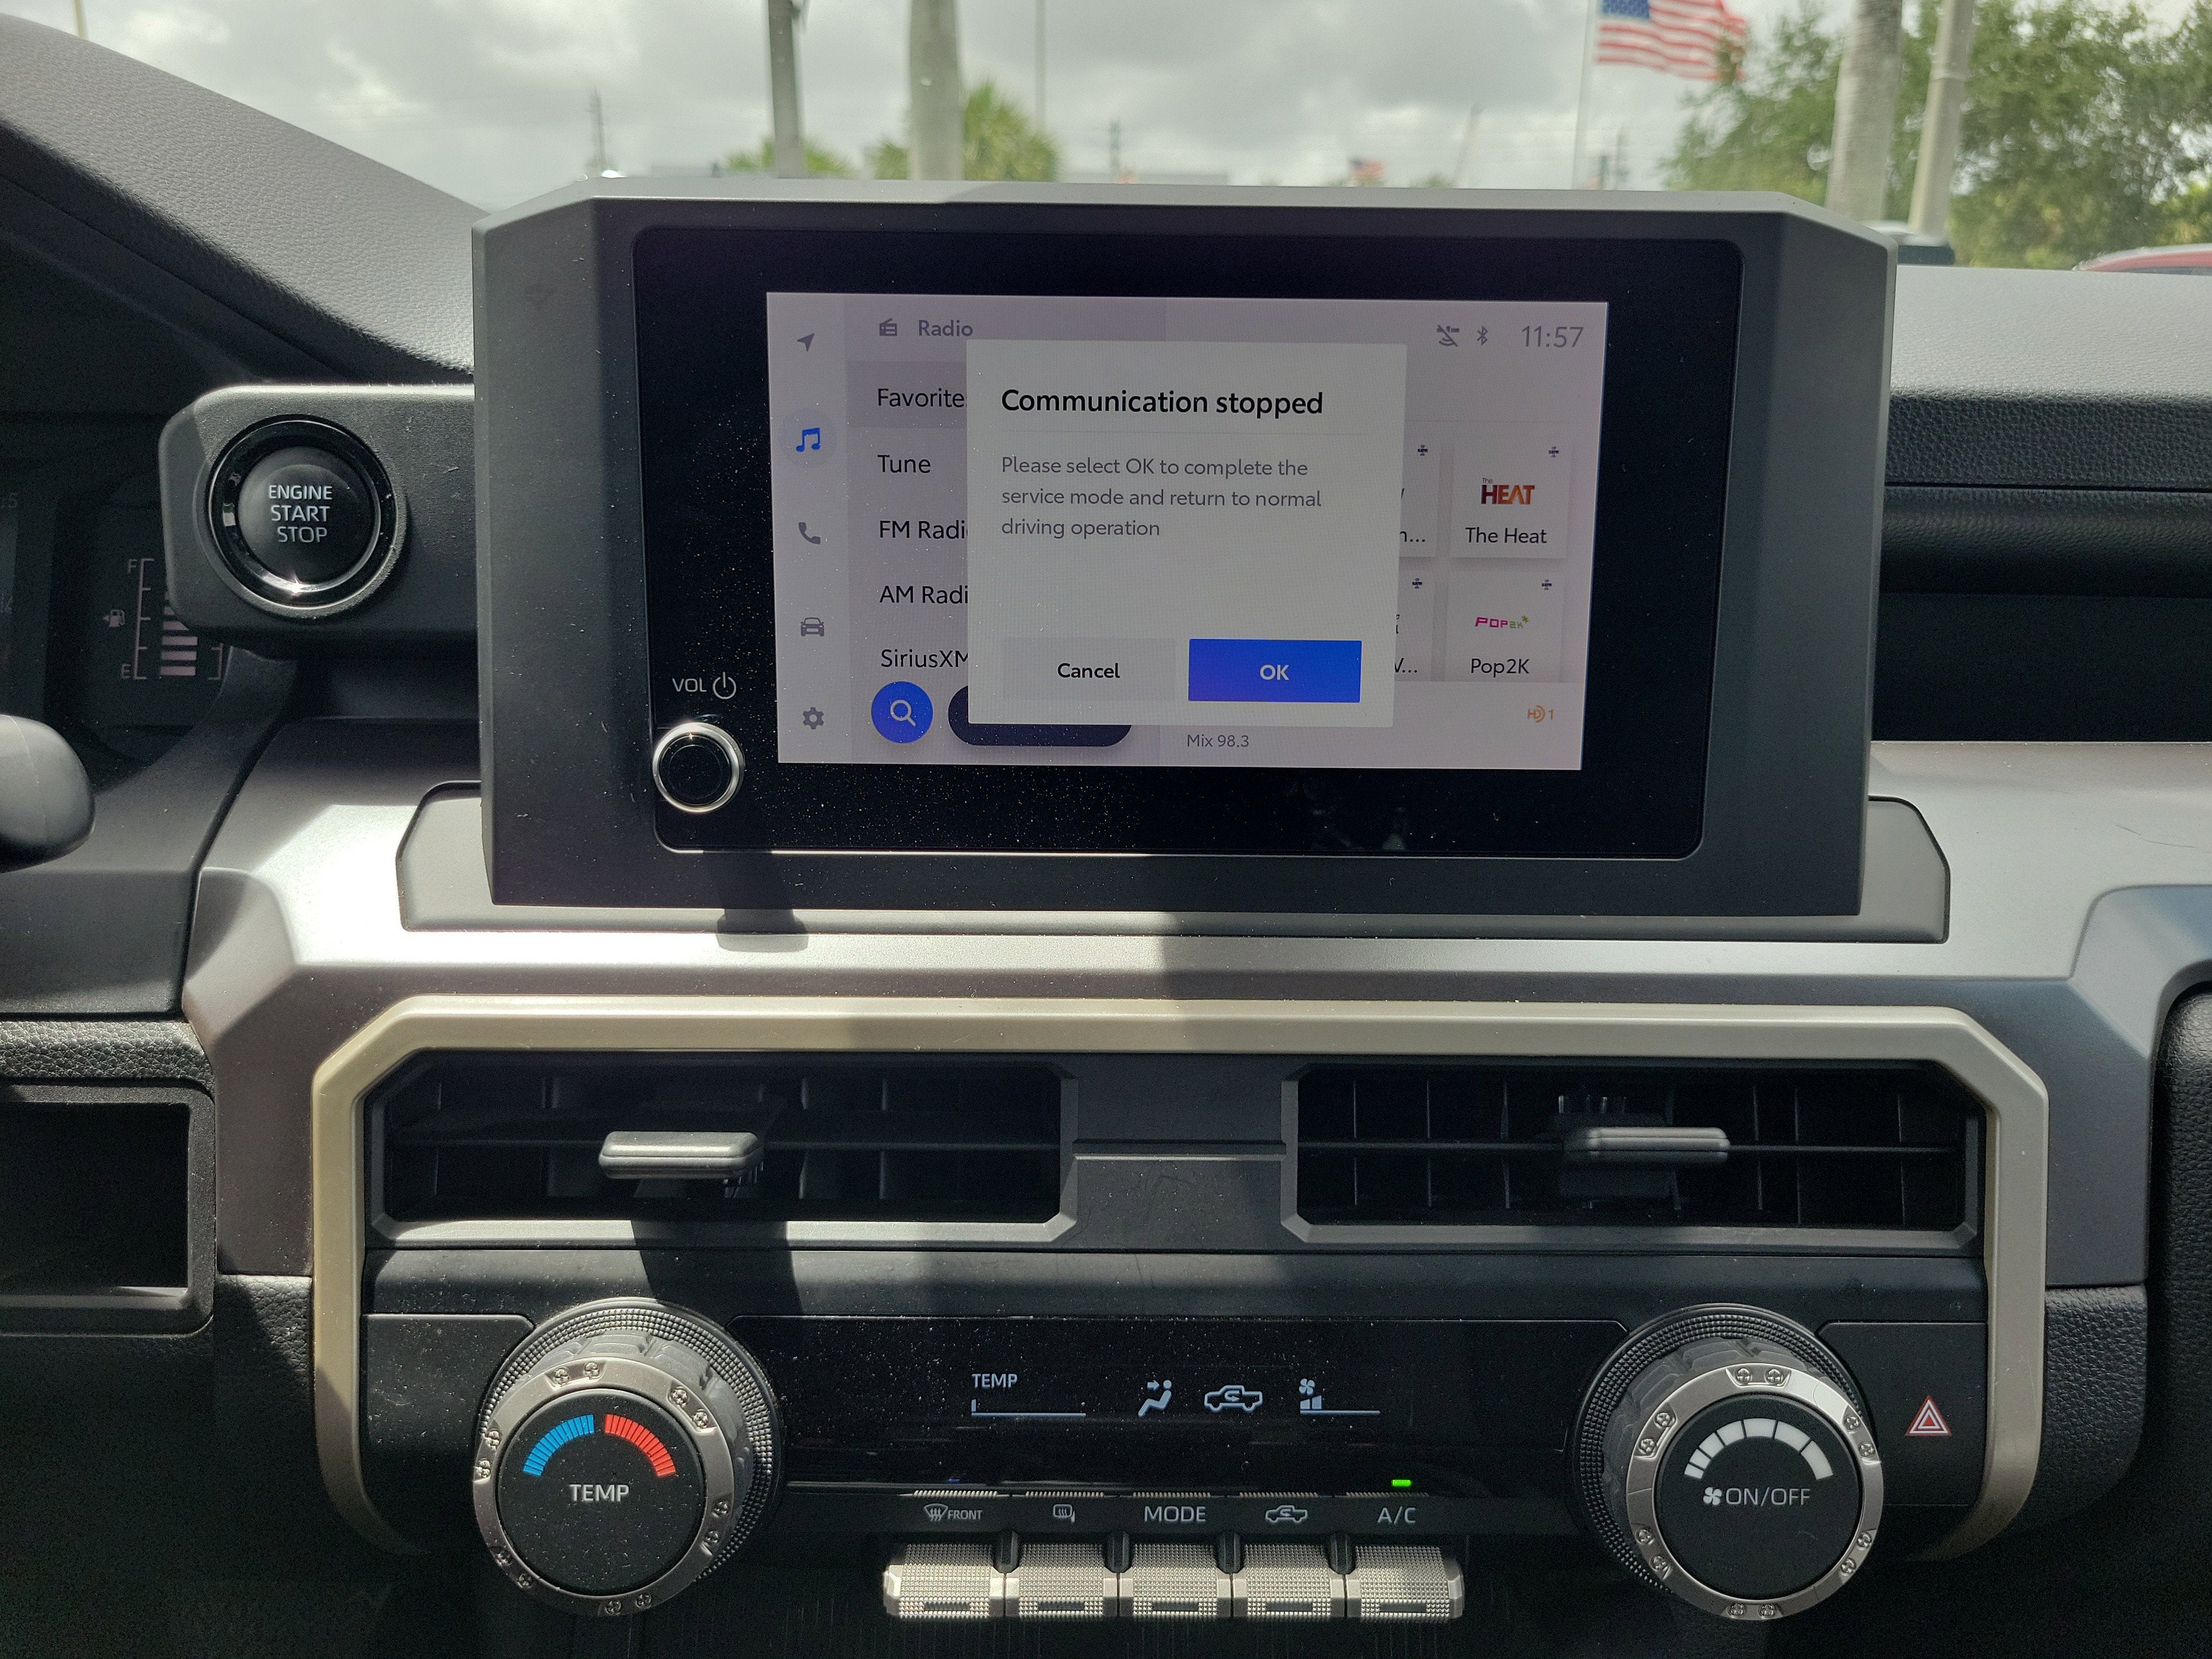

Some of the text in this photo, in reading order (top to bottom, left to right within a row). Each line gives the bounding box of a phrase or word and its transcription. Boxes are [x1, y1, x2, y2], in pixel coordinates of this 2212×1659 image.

[918, 319, 973, 337] Radio
[1522, 325, 1584, 348] 11:57
[878, 387, 967, 408] Favorite
[1002, 389, 1323, 419] Communication stopped
[877, 454, 931, 473] Tune
[1002, 456, 1308, 479] Please select OK to complete the
[268, 484, 332, 500] ENGINE
[1002, 488, 1322, 507] service mode and return to normal
[1481, 484, 1535, 504] HEAT
[270, 504, 330, 521] START
[276, 526, 327, 543] STOP
[880, 520, 968, 539] FM Radi
[1001, 517, 1160, 540] driving operation
[1465, 527, 1547, 544] The Heat
[127, 558, 138, 573] F
[879, 585, 913, 603] AM
[881, 648, 968, 668] SiriusXM
[121, 663, 131, 679] E
[1057, 662, 1120, 679] Cancel
[1260, 664, 1289, 680] OK
[1471, 658, 1530, 678] Pop2K
[672, 678, 707, 692] VOL
[1187, 734, 1249, 748] Mix 98.3
[972, 1373, 1018, 1388] TEMP
[569, 1484, 629, 1502] TEMP
[1725, 1487, 1810, 1506] ON/OFF
[947, 1510, 982, 1520] FRONT
[1144, 1506, 1206, 1522] MODE
[1377, 1506, 1415, 1524] A/C
